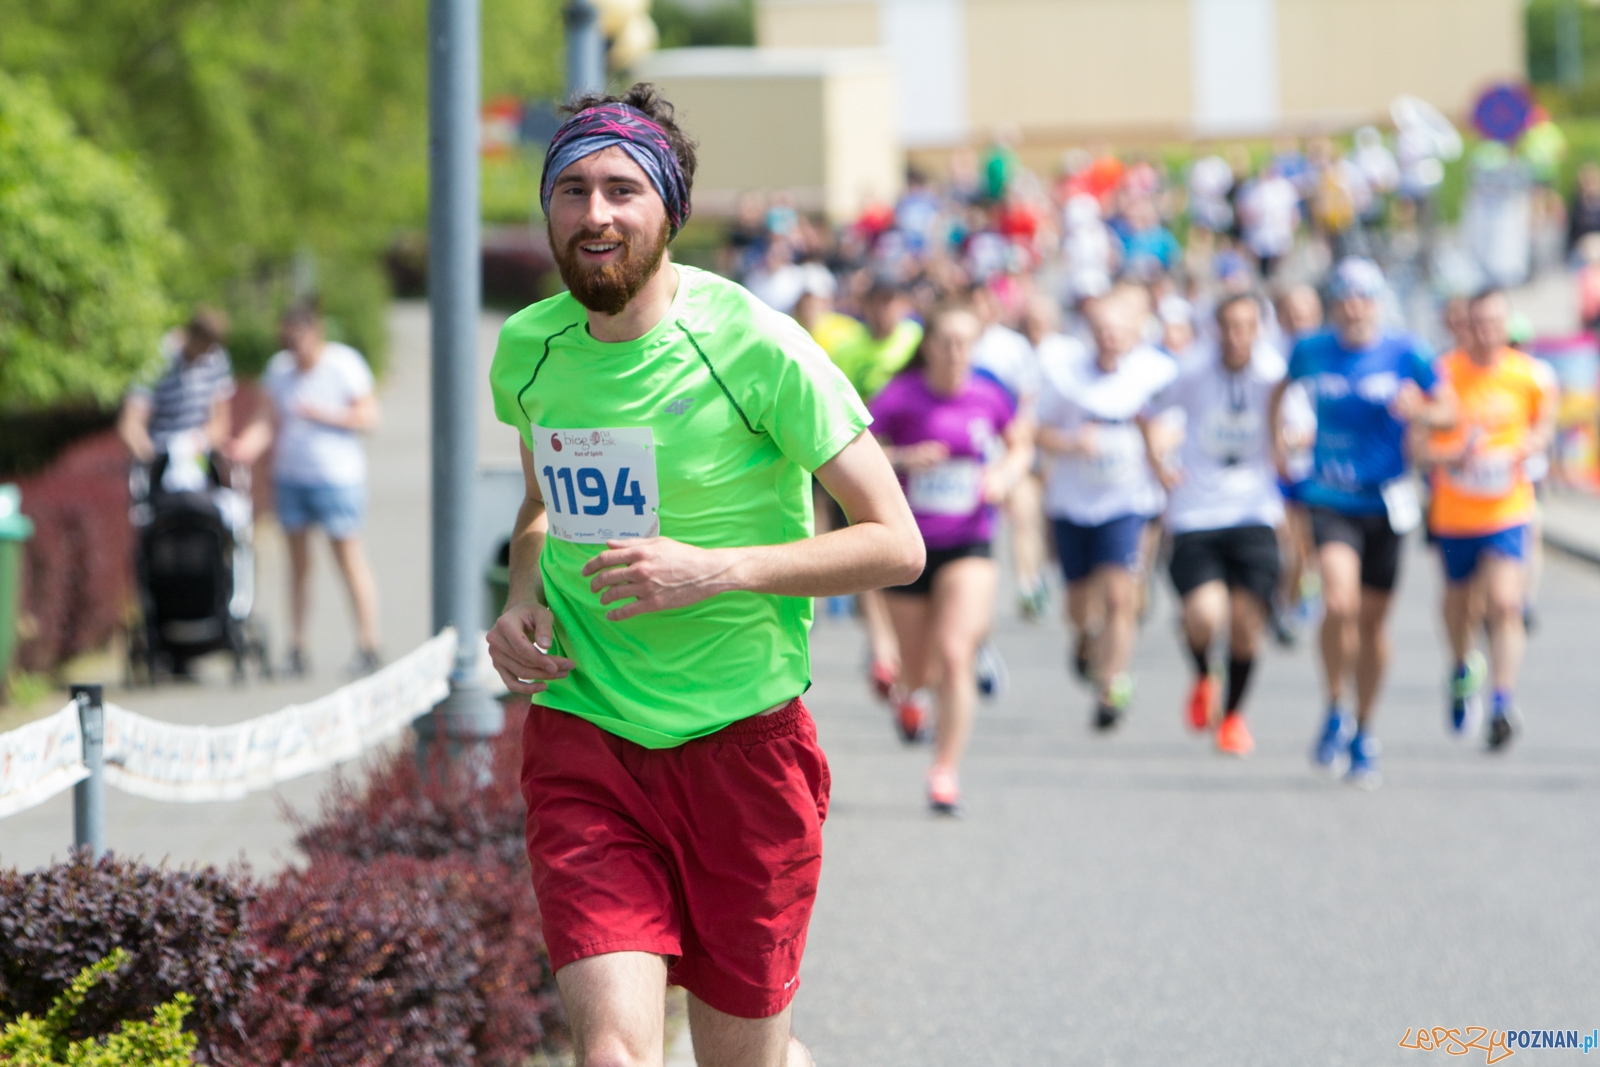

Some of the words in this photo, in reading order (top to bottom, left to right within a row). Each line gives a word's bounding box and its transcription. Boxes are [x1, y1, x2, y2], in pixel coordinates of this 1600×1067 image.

[664, 398, 694, 416] 4F
[563, 432, 591, 451] bieg
[542, 465, 647, 516] 1194
